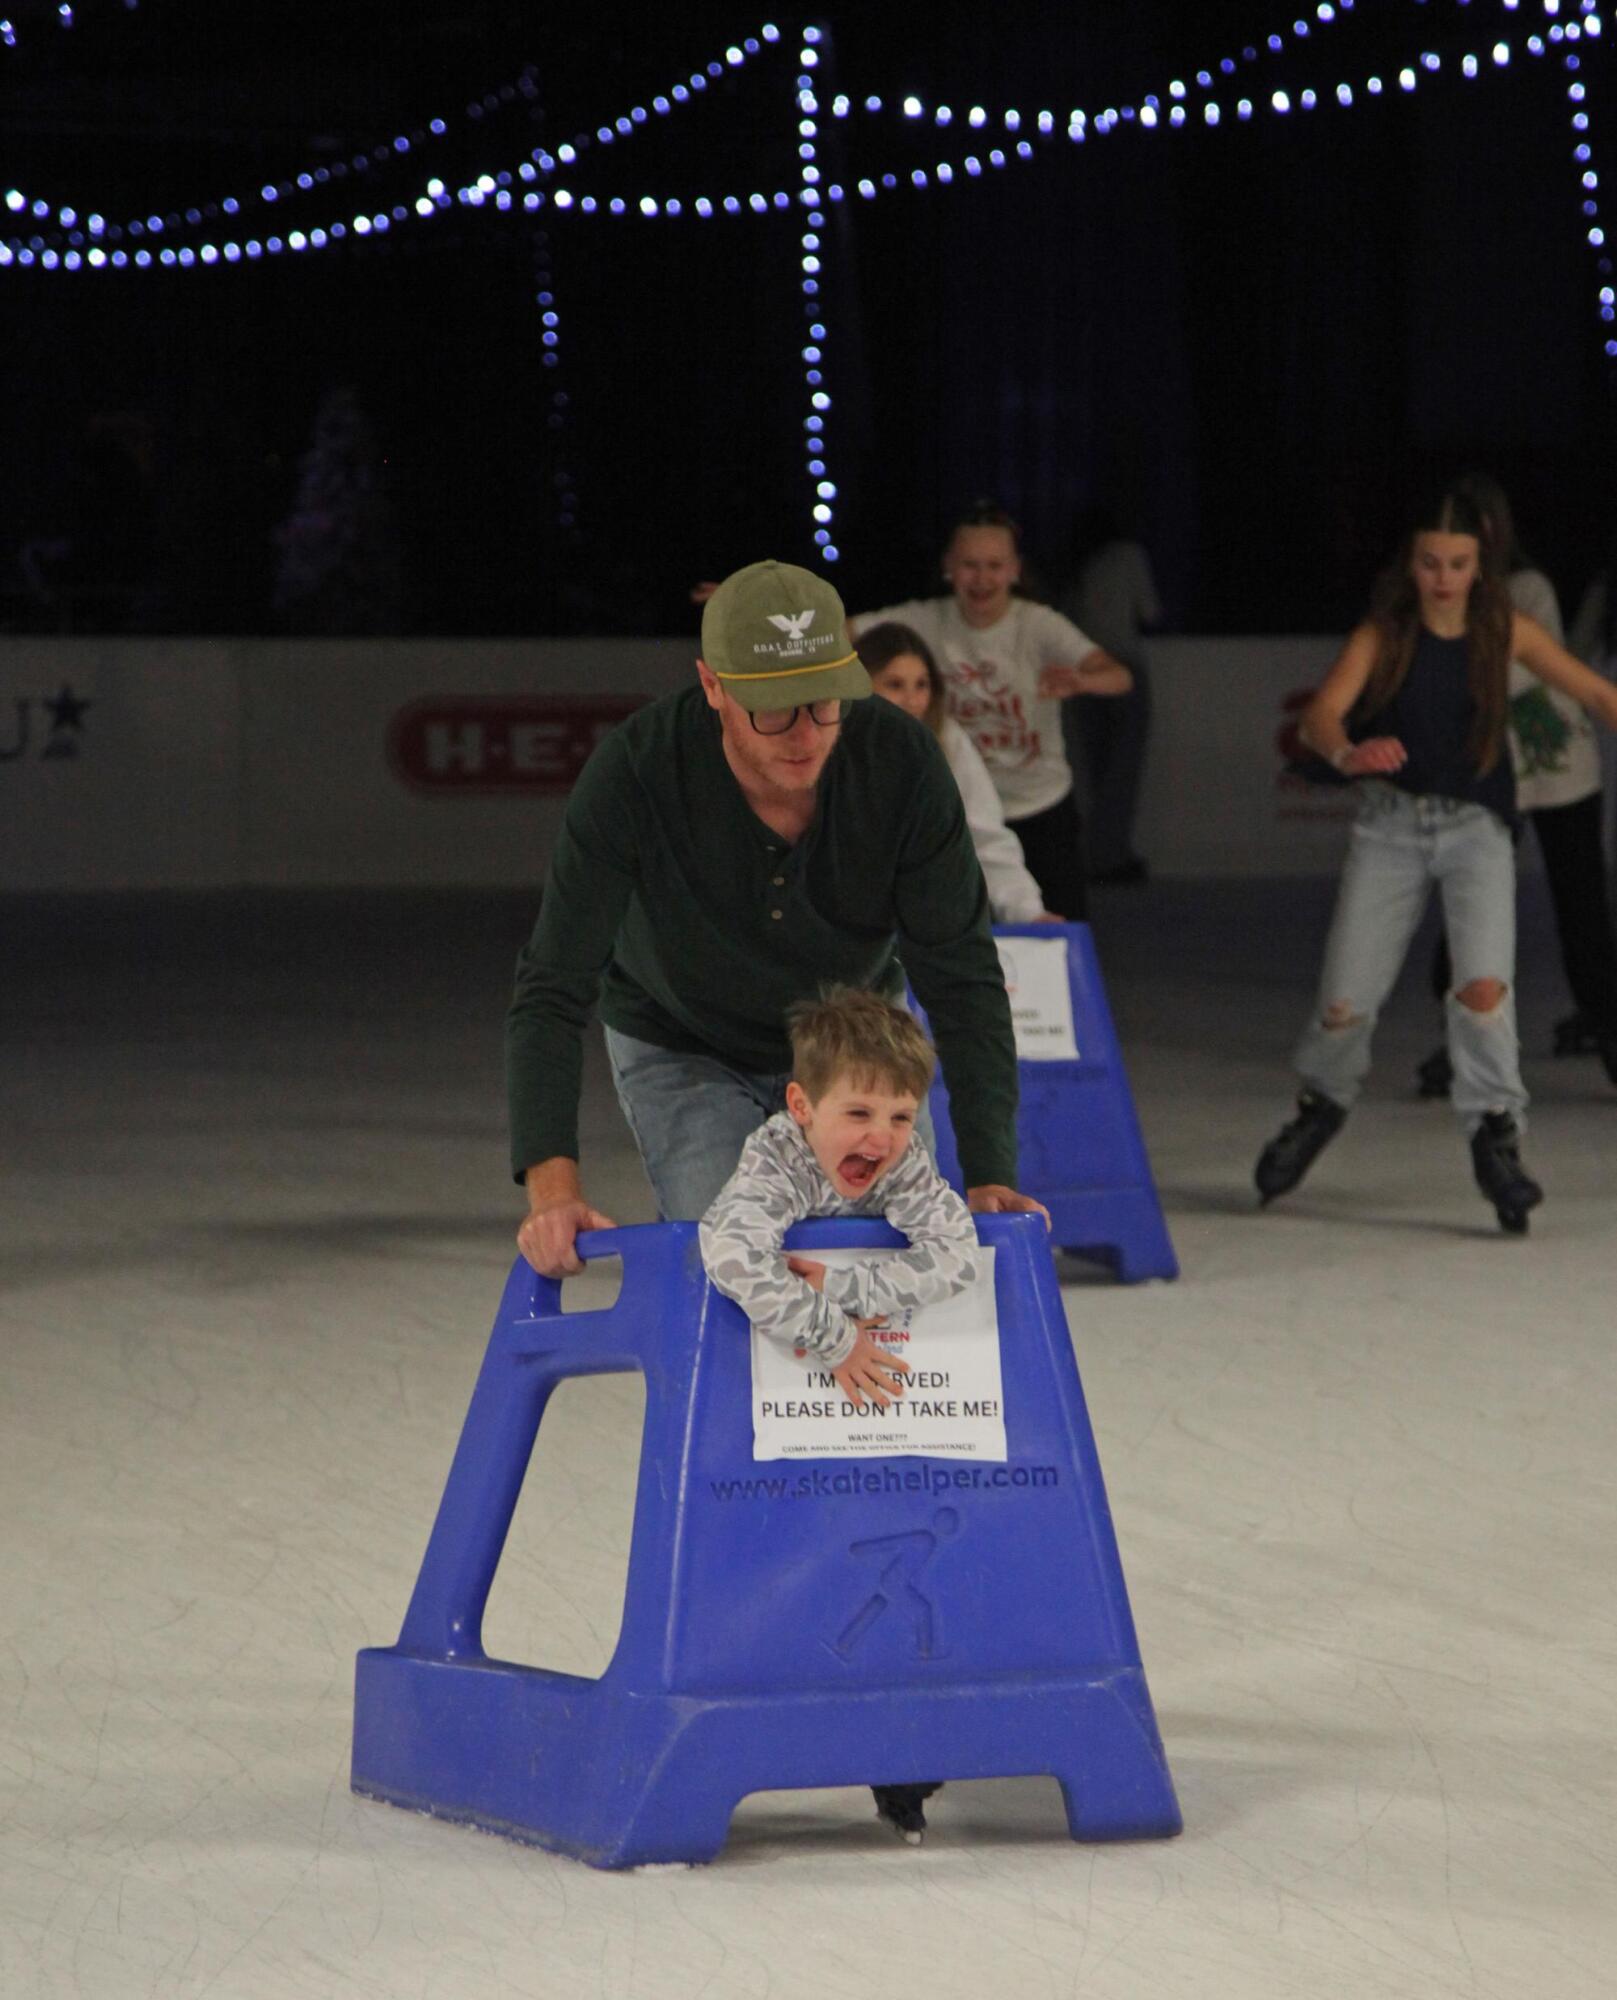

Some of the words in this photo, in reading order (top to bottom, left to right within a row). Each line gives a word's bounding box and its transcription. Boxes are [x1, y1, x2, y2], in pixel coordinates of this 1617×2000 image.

[806, 1371, 836, 1389] I'M
[761, 1401, 836, 1419] PLEASE
[909, 1399, 957, 1417] TAKE
[963, 1399, 998, 1417] ME!
[847, 1433, 874, 1442] WANT
[875, 1432, 908, 1442] ONE???
[709, 1464, 1059, 1500] www.skatehelper.com
